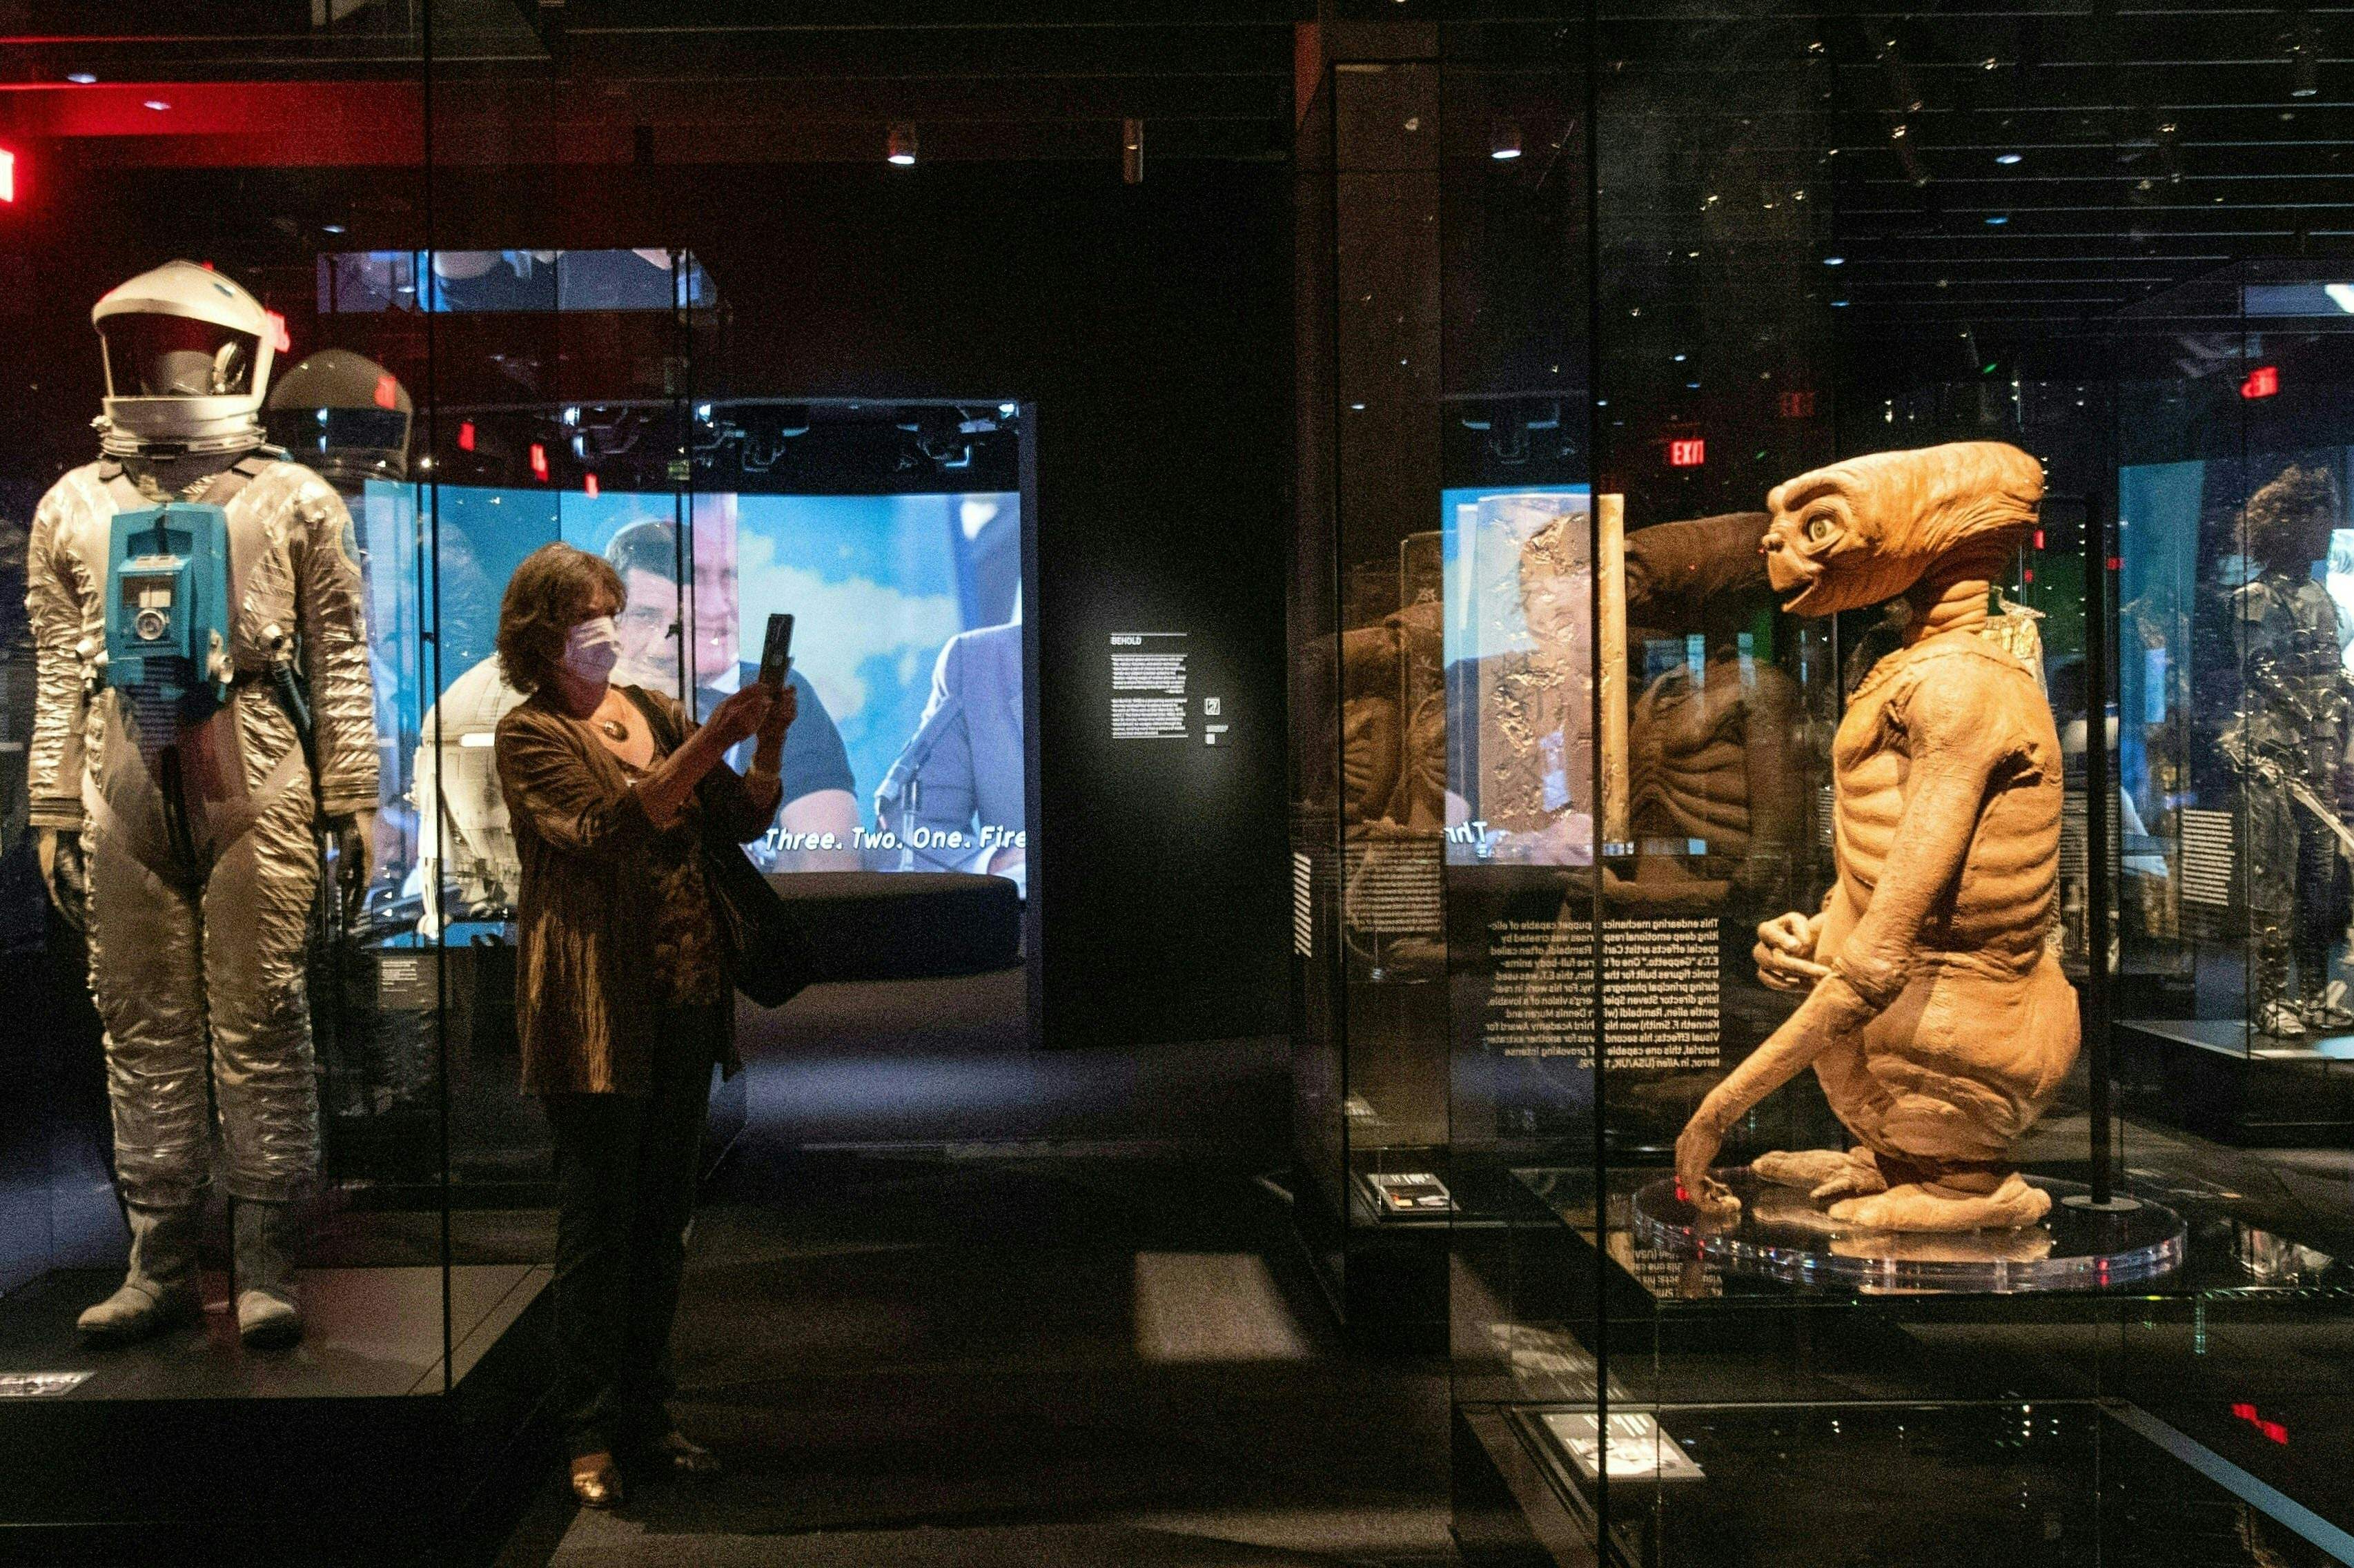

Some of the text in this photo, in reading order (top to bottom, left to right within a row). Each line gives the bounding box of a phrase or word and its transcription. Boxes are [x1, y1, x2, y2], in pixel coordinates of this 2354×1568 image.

[1672, 440, 1705, 465] EXIT
[1110, 636, 1141, 645] BEHOLD
[765, 824, 1026, 850] Three. Two. One. Fire
